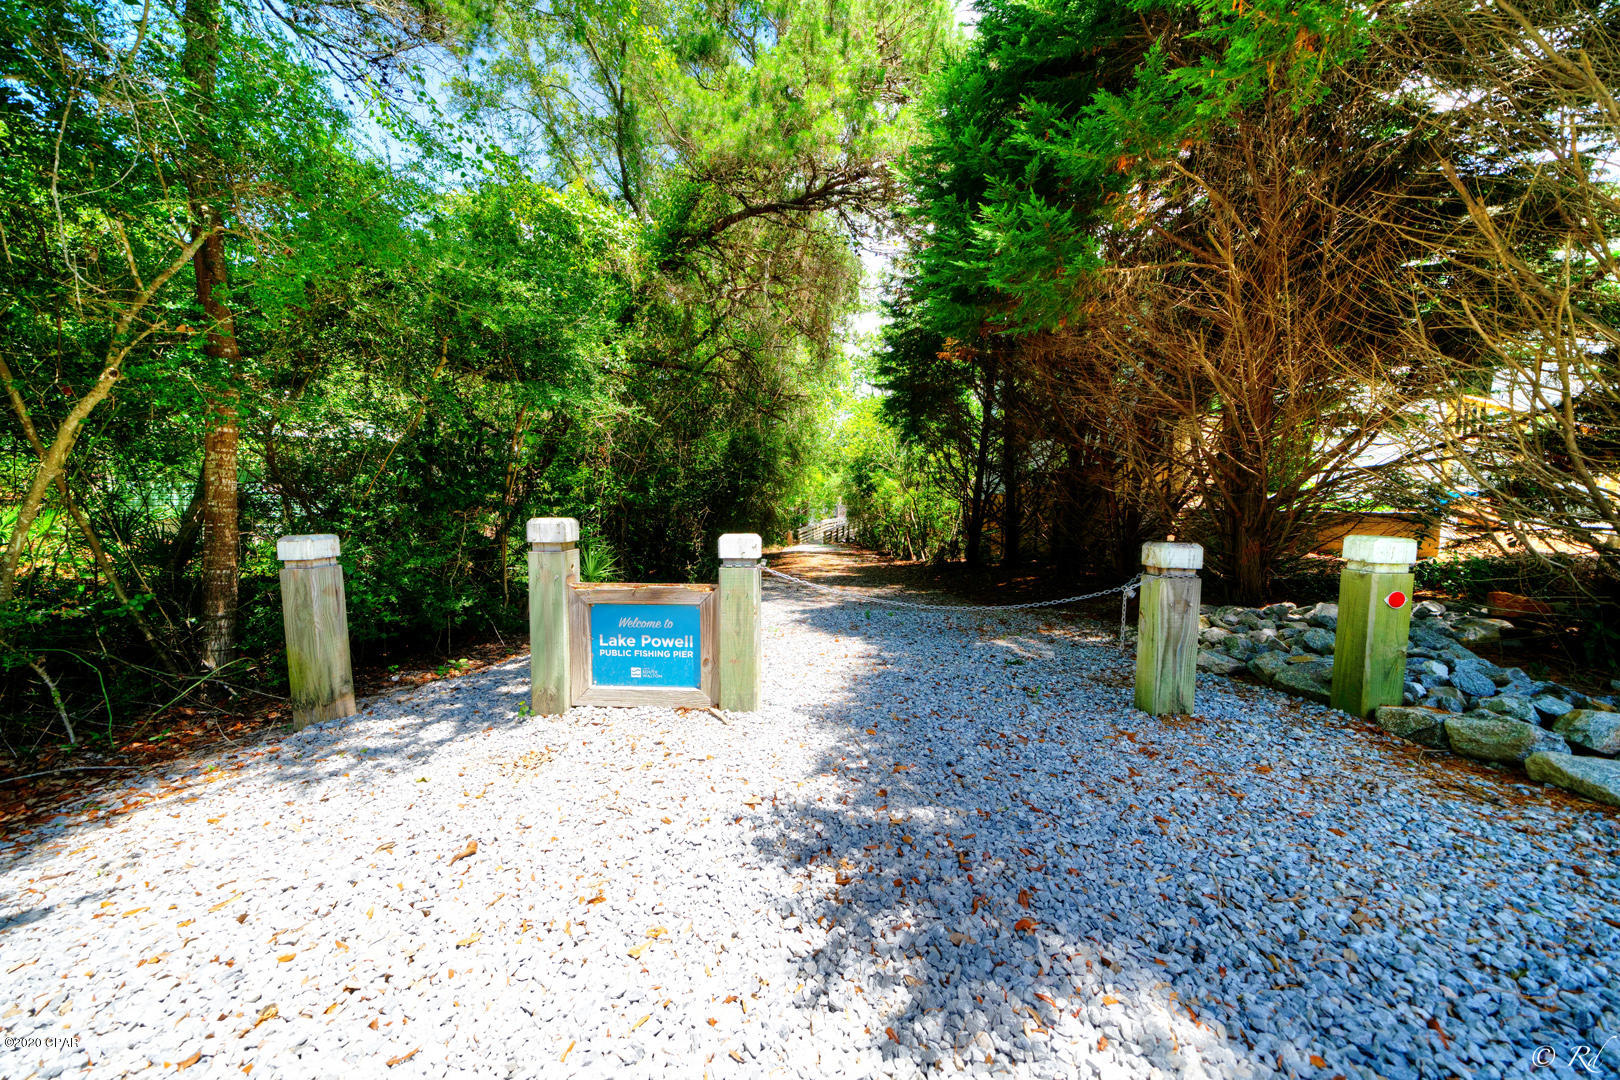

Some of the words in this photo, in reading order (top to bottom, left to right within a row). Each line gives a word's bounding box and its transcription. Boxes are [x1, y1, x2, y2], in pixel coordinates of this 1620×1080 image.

[619, 617, 661, 628] Welcome
[664, 618, 674, 628] to
[599, 634, 636, 647] Lake
[641, 634, 693, 648] Powell
[599, 649, 632, 657] PUBLIC
[634, 649, 671, 658] FISHING
[673, 650, 693, 658] PIER
